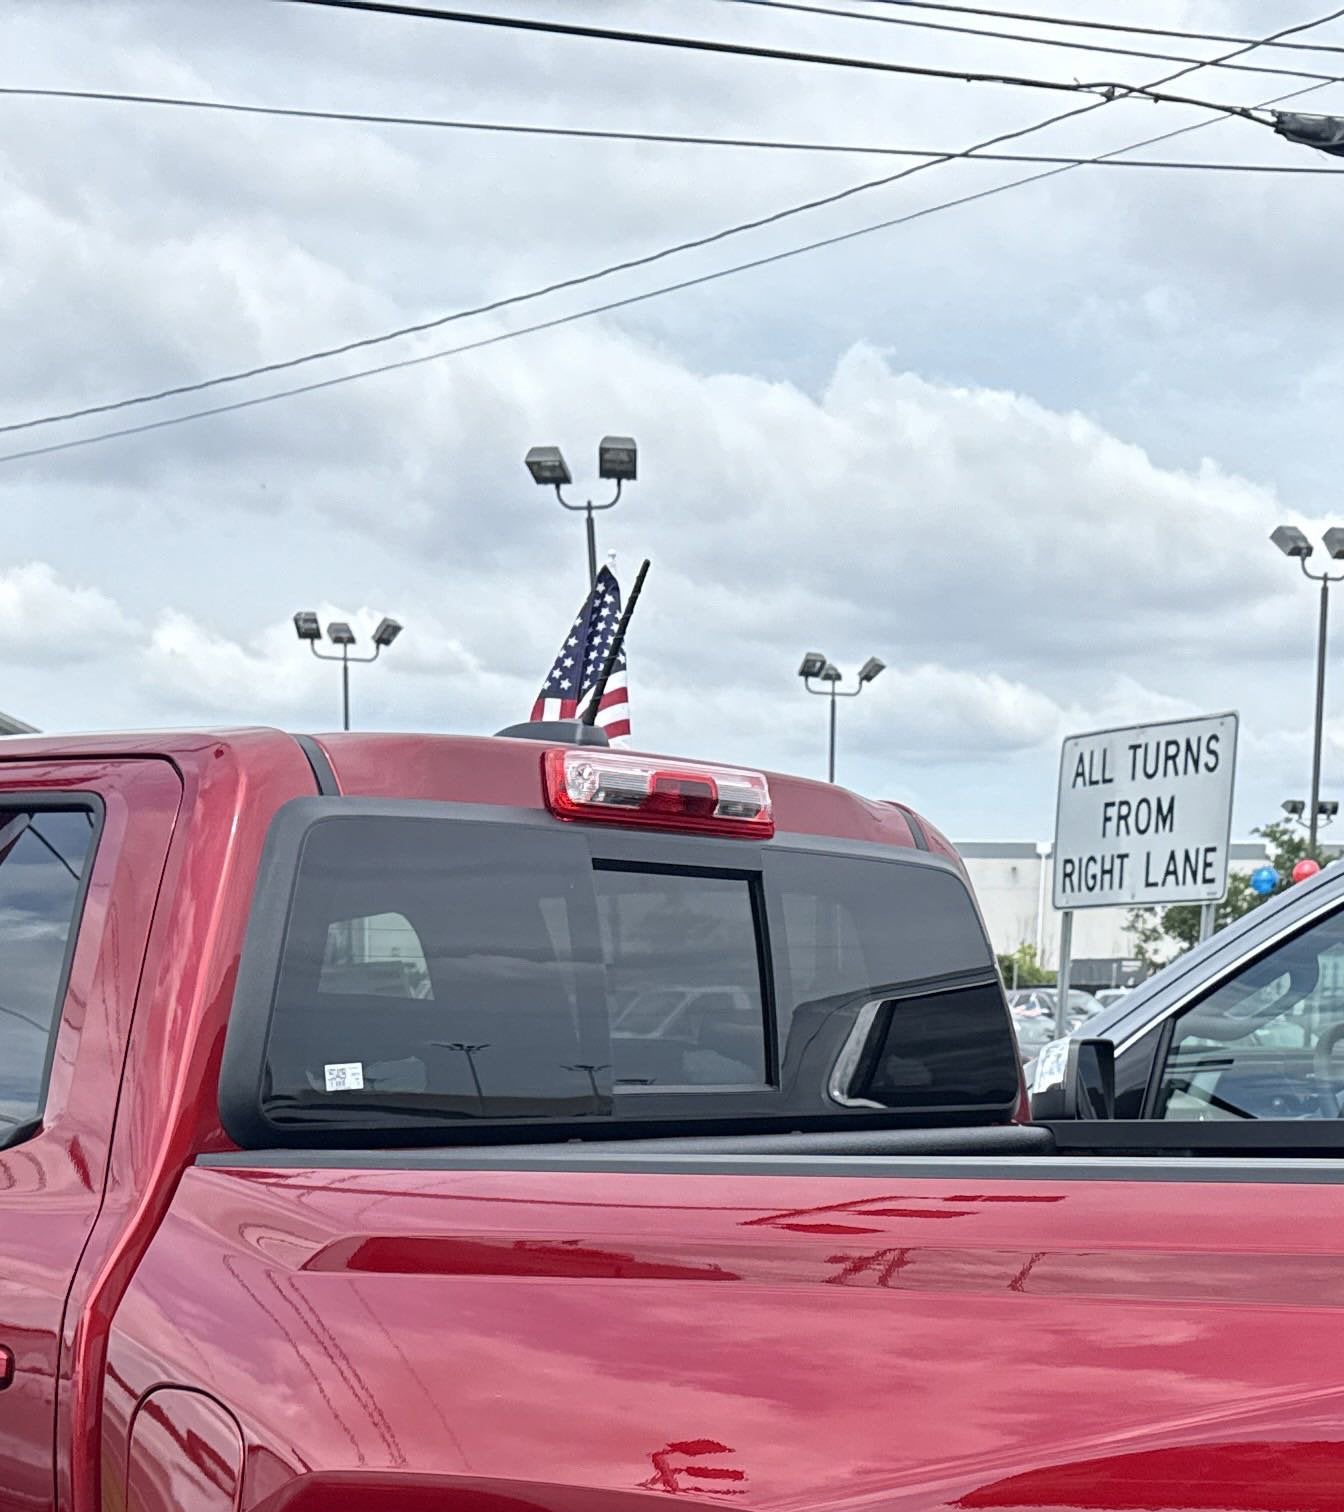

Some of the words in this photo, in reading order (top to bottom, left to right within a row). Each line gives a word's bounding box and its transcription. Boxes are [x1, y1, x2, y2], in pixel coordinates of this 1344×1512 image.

[1072, 748, 1114, 789] ALL
[1128, 733, 1221, 781] TURNS
[1102, 795, 1175, 838] FROM
[1062, 853, 1129, 894] RIGHT
[1144, 846, 1217, 888] LANE
